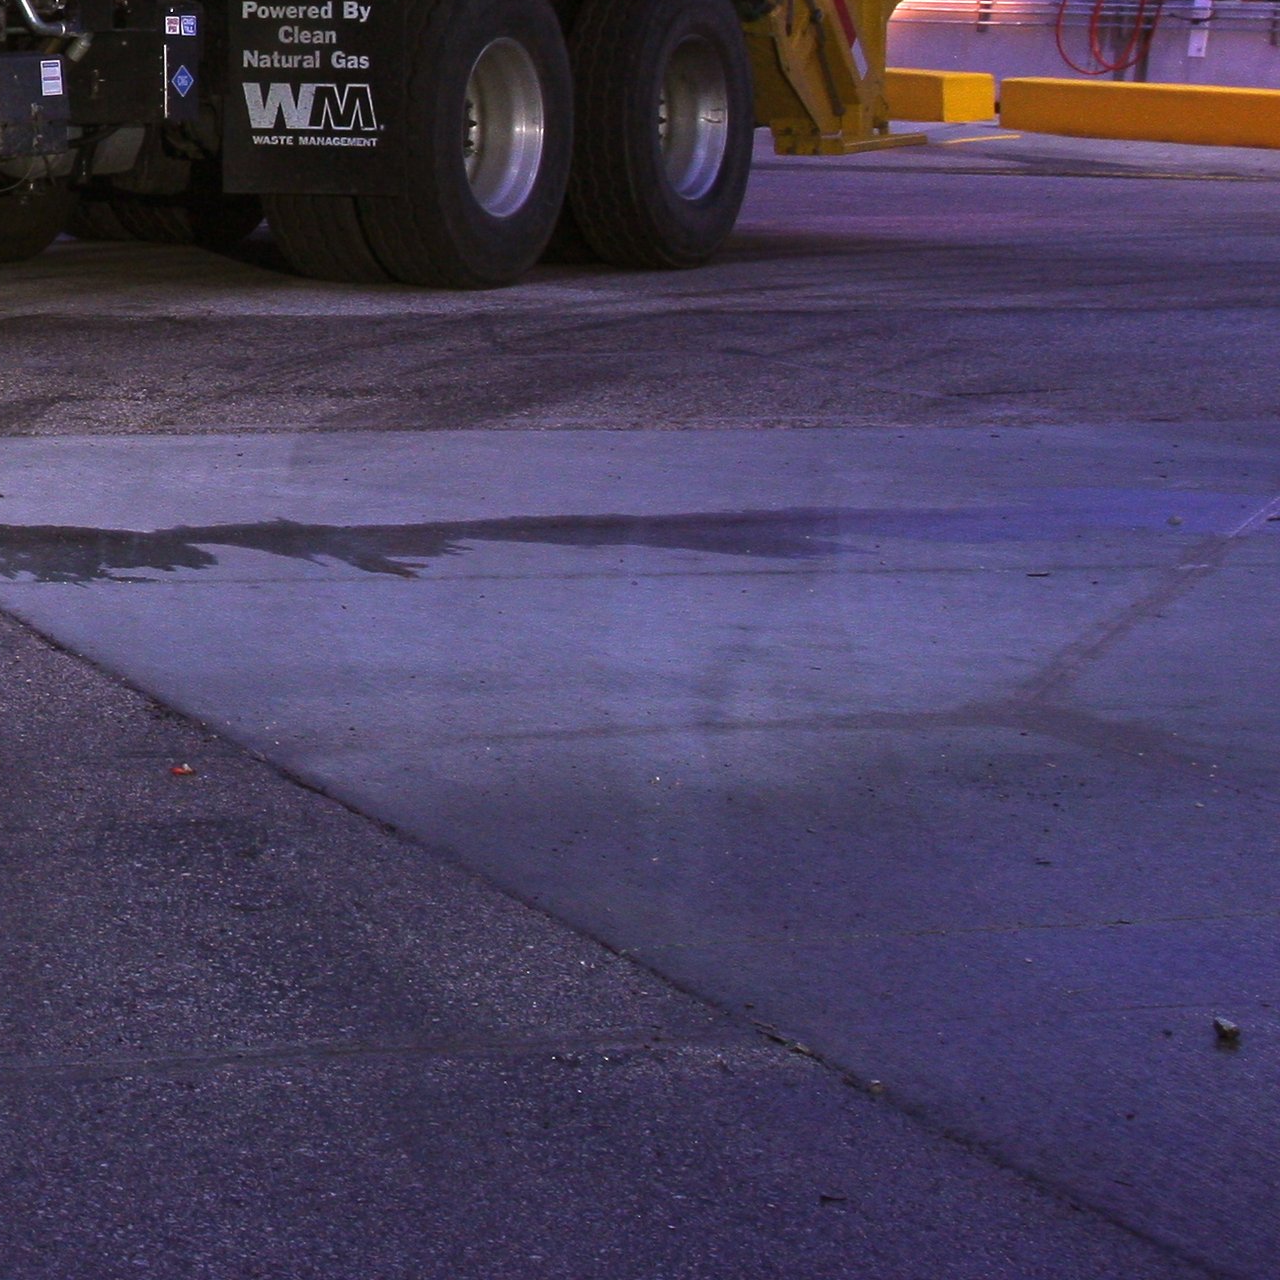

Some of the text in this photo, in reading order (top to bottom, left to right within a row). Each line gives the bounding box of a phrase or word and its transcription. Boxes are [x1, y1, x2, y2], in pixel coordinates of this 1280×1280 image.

[241, 1, 371, 23] Powered By
[278, 25, 337, 44] Clean
[242, 50, 370, 69] Natural Gas
[242, 82, 377, 131] WM
[252, 135, 378, 147] WASTE MANAGEMENT
